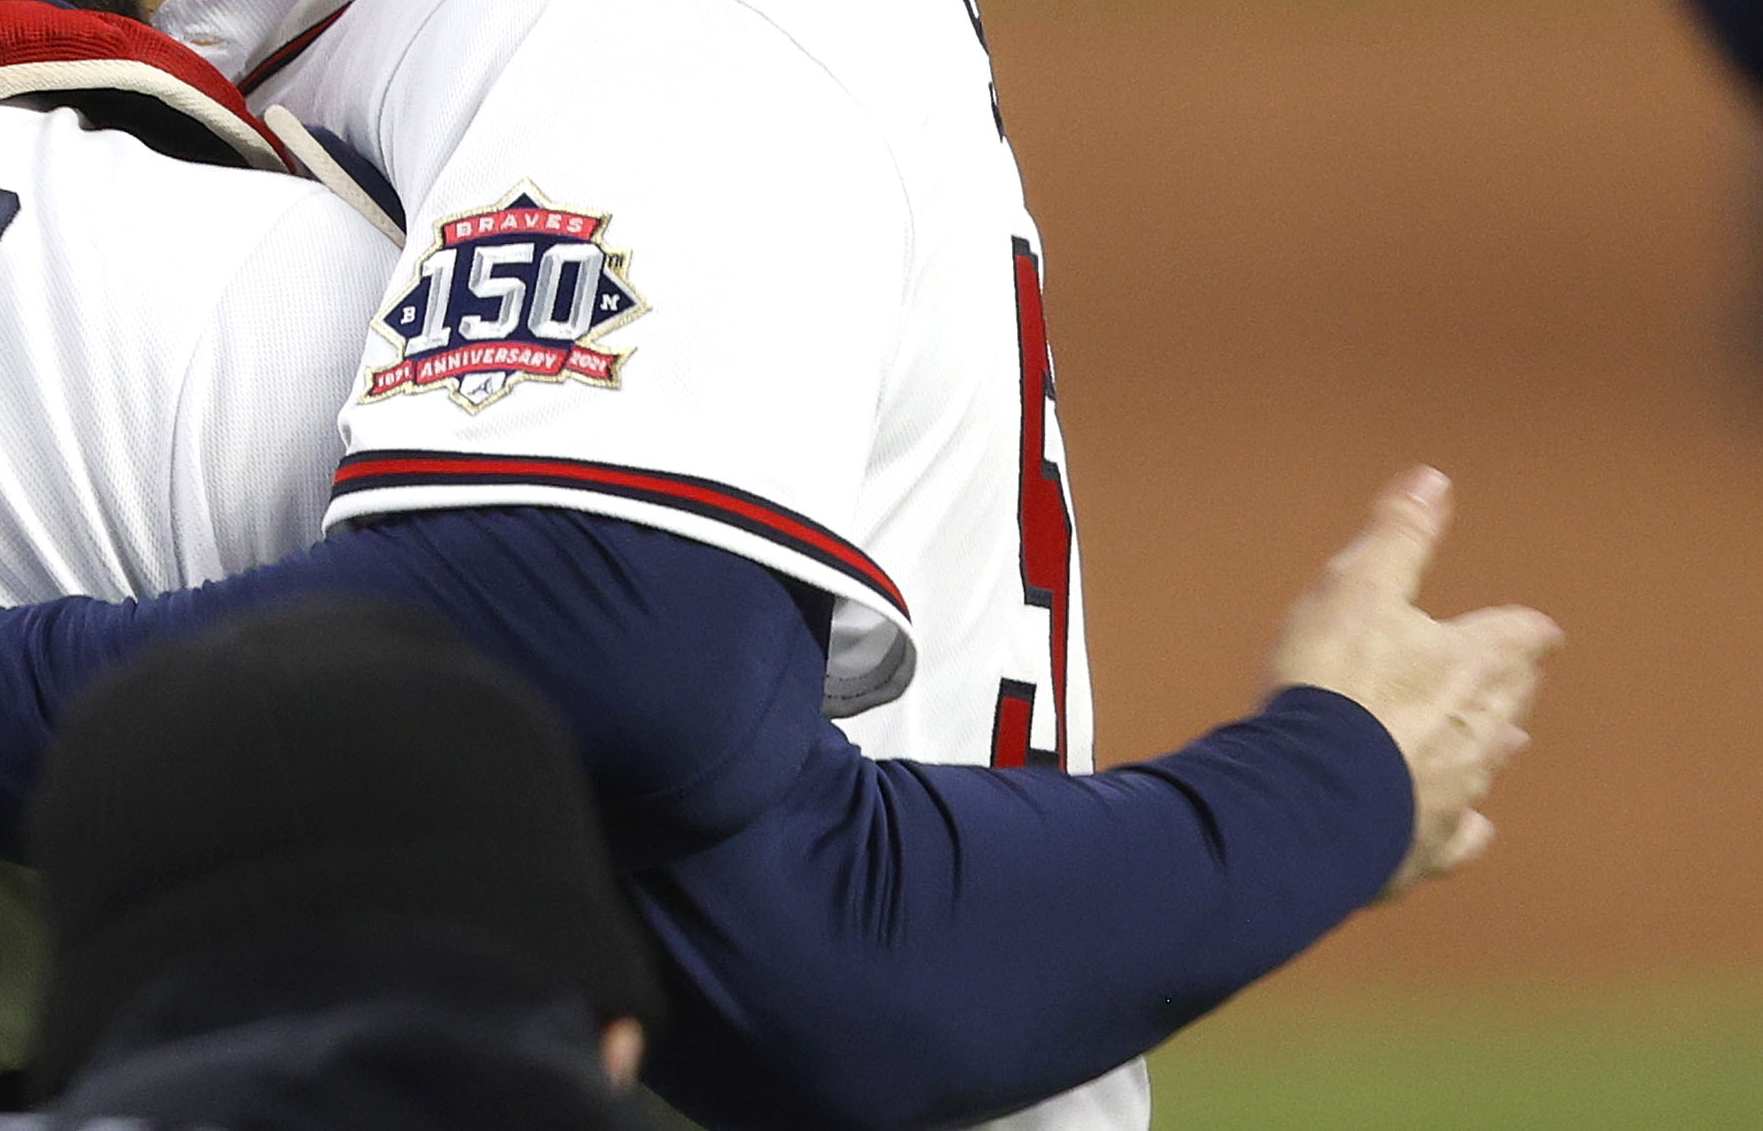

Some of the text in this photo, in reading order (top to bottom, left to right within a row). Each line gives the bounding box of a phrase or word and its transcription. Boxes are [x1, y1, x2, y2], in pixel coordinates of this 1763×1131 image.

[455, 211, 584, 238] BRAVES
[404, 242, 605, 357] 150
[400, 305, 417, 325] B
[419, 346, 557, 379] ANNIVERSARY
